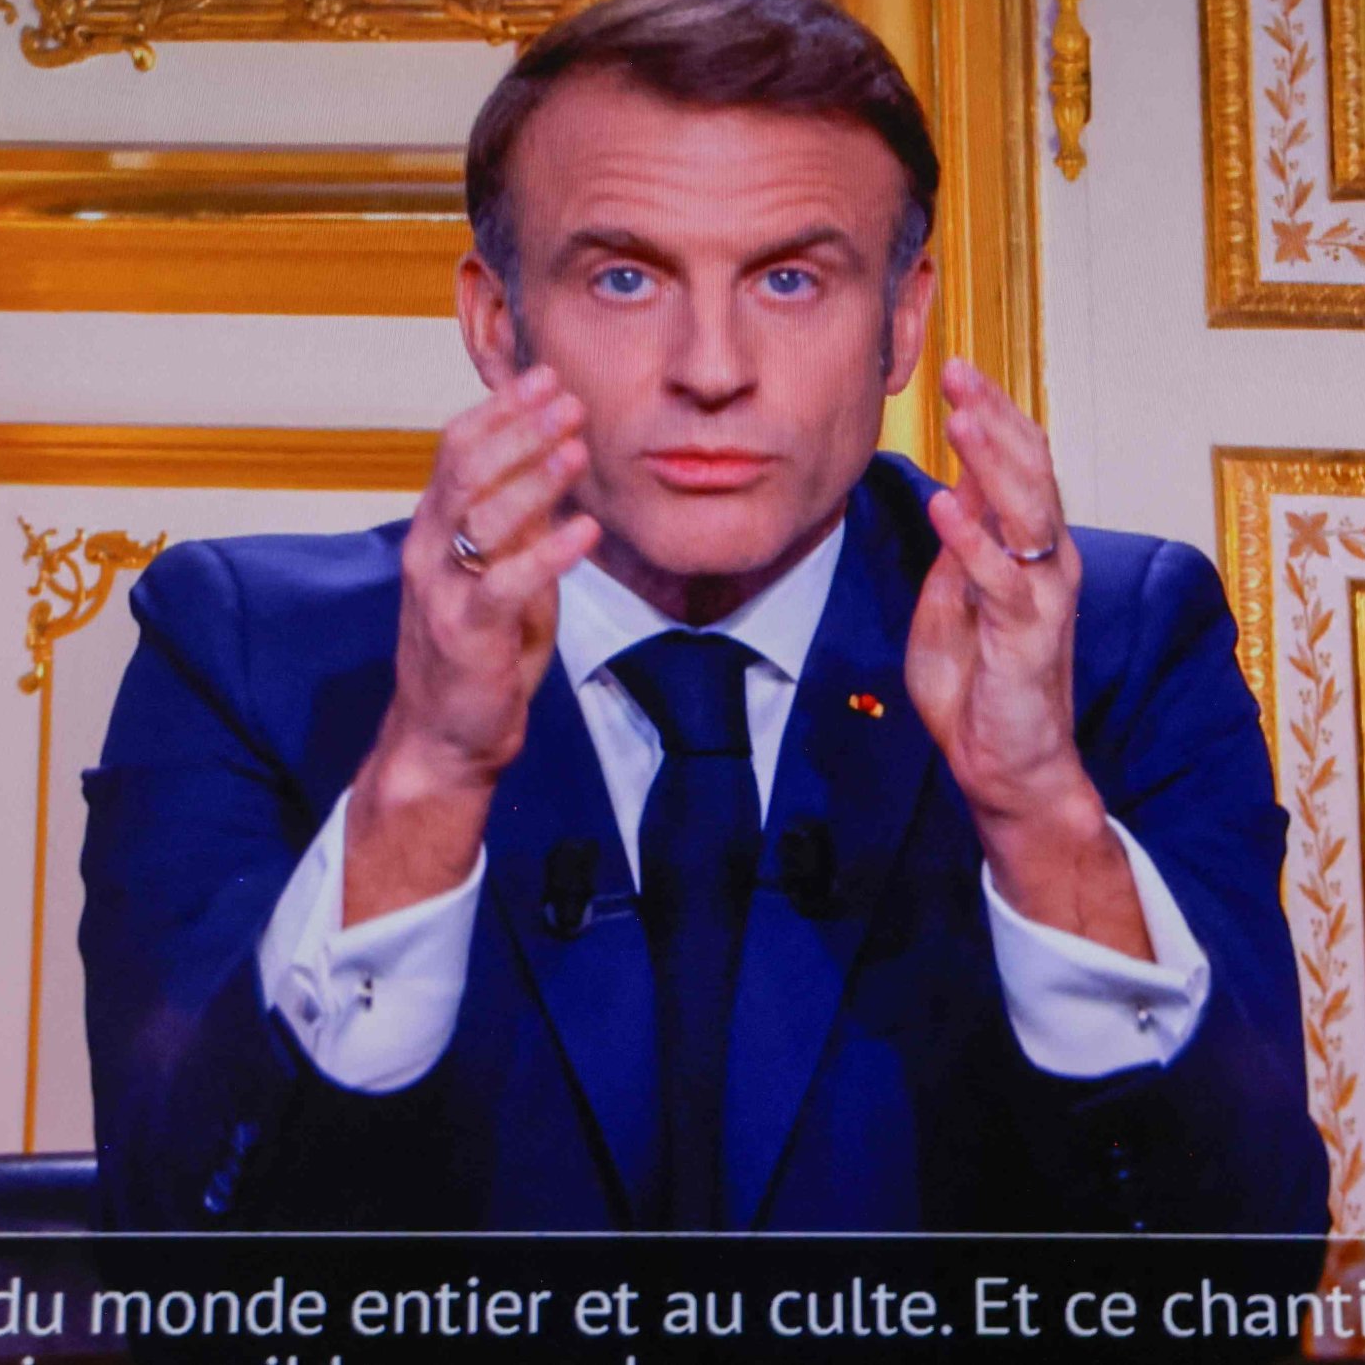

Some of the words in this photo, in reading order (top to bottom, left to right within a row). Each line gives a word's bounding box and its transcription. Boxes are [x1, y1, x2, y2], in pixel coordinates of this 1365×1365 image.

[90, 1276, 328, 1336] monde
[350, 1276, 552, 1335] entier
[574, 1282, 640, 1336] et
[662, 1291, 743, 1336] au
[769, 1276, 954, 1336] culte.
[974, 1276, 1041, 1336] Et
[1064, 1291, 1137, 1337] ce
